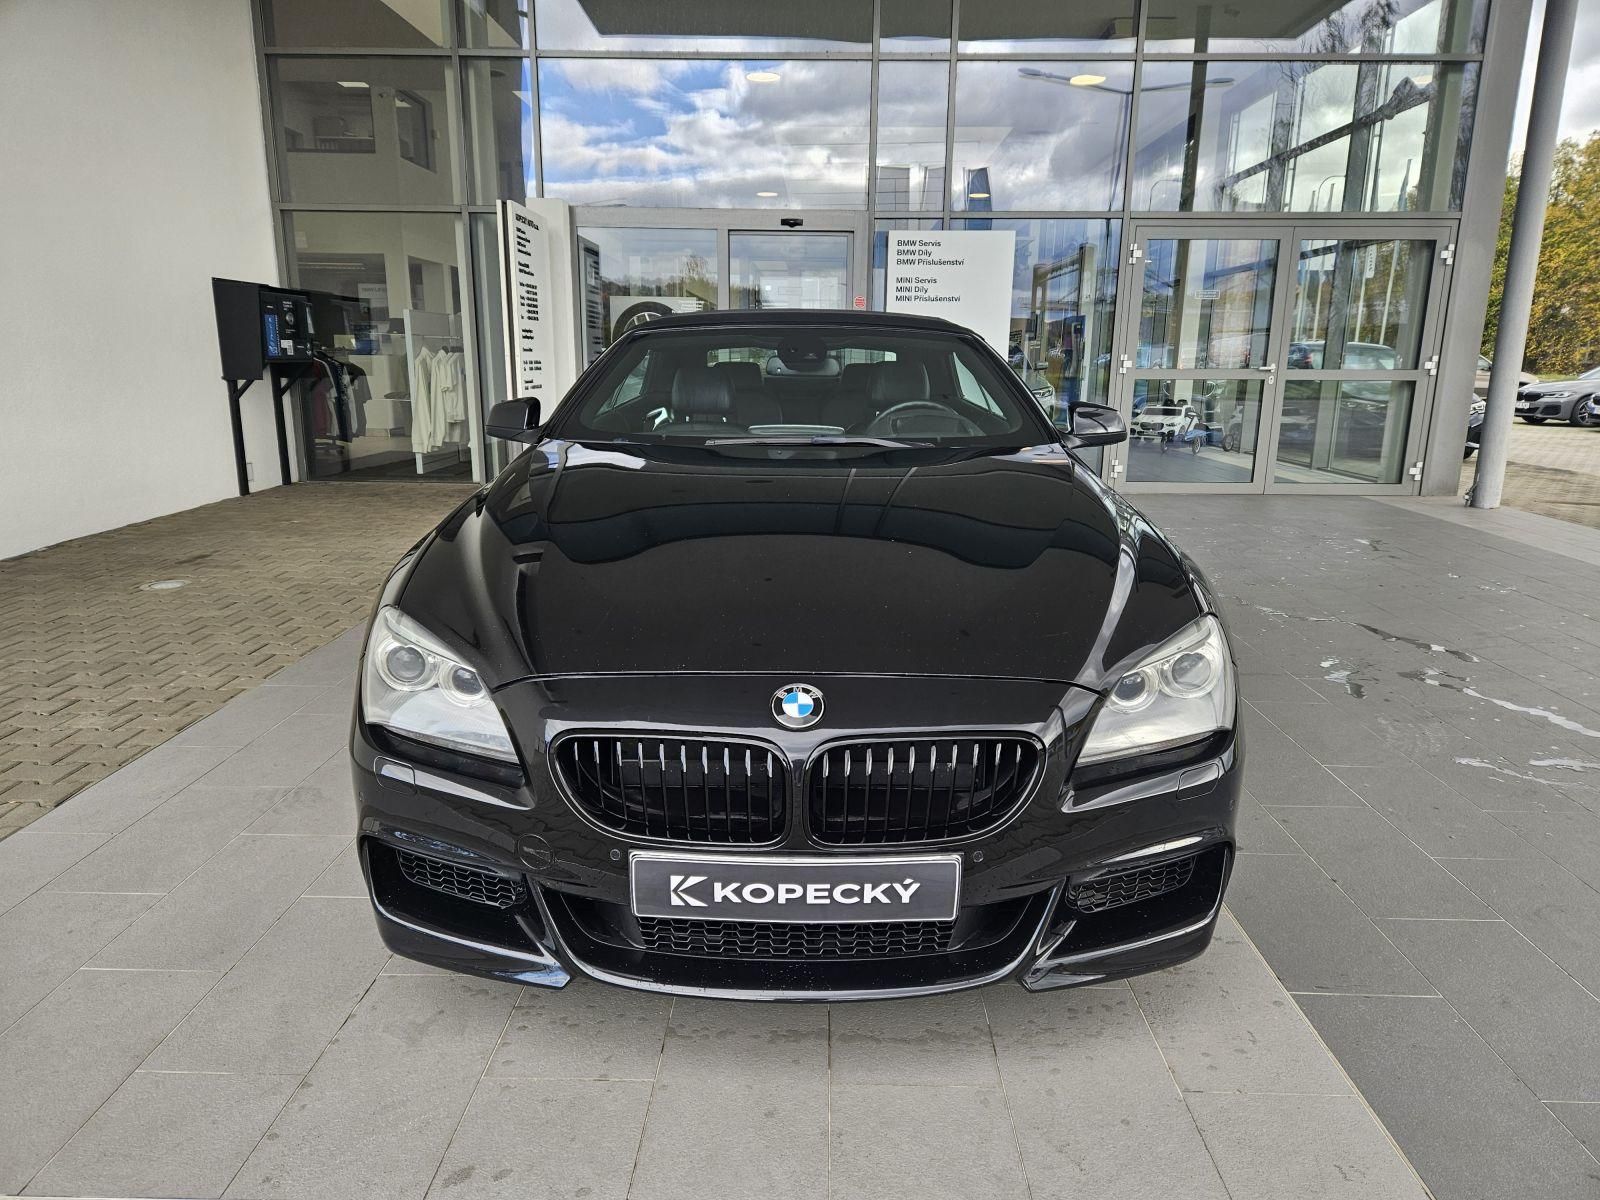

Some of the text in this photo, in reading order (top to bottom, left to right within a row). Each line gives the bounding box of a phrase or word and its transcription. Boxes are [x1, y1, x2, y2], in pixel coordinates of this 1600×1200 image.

[897, 239, 941, 247] BMW Servis
[897, 258, 916, 266] BMW
[777, 687, 820, 699] BMW
[713, 878, 921, 905] KOPECKÝ
